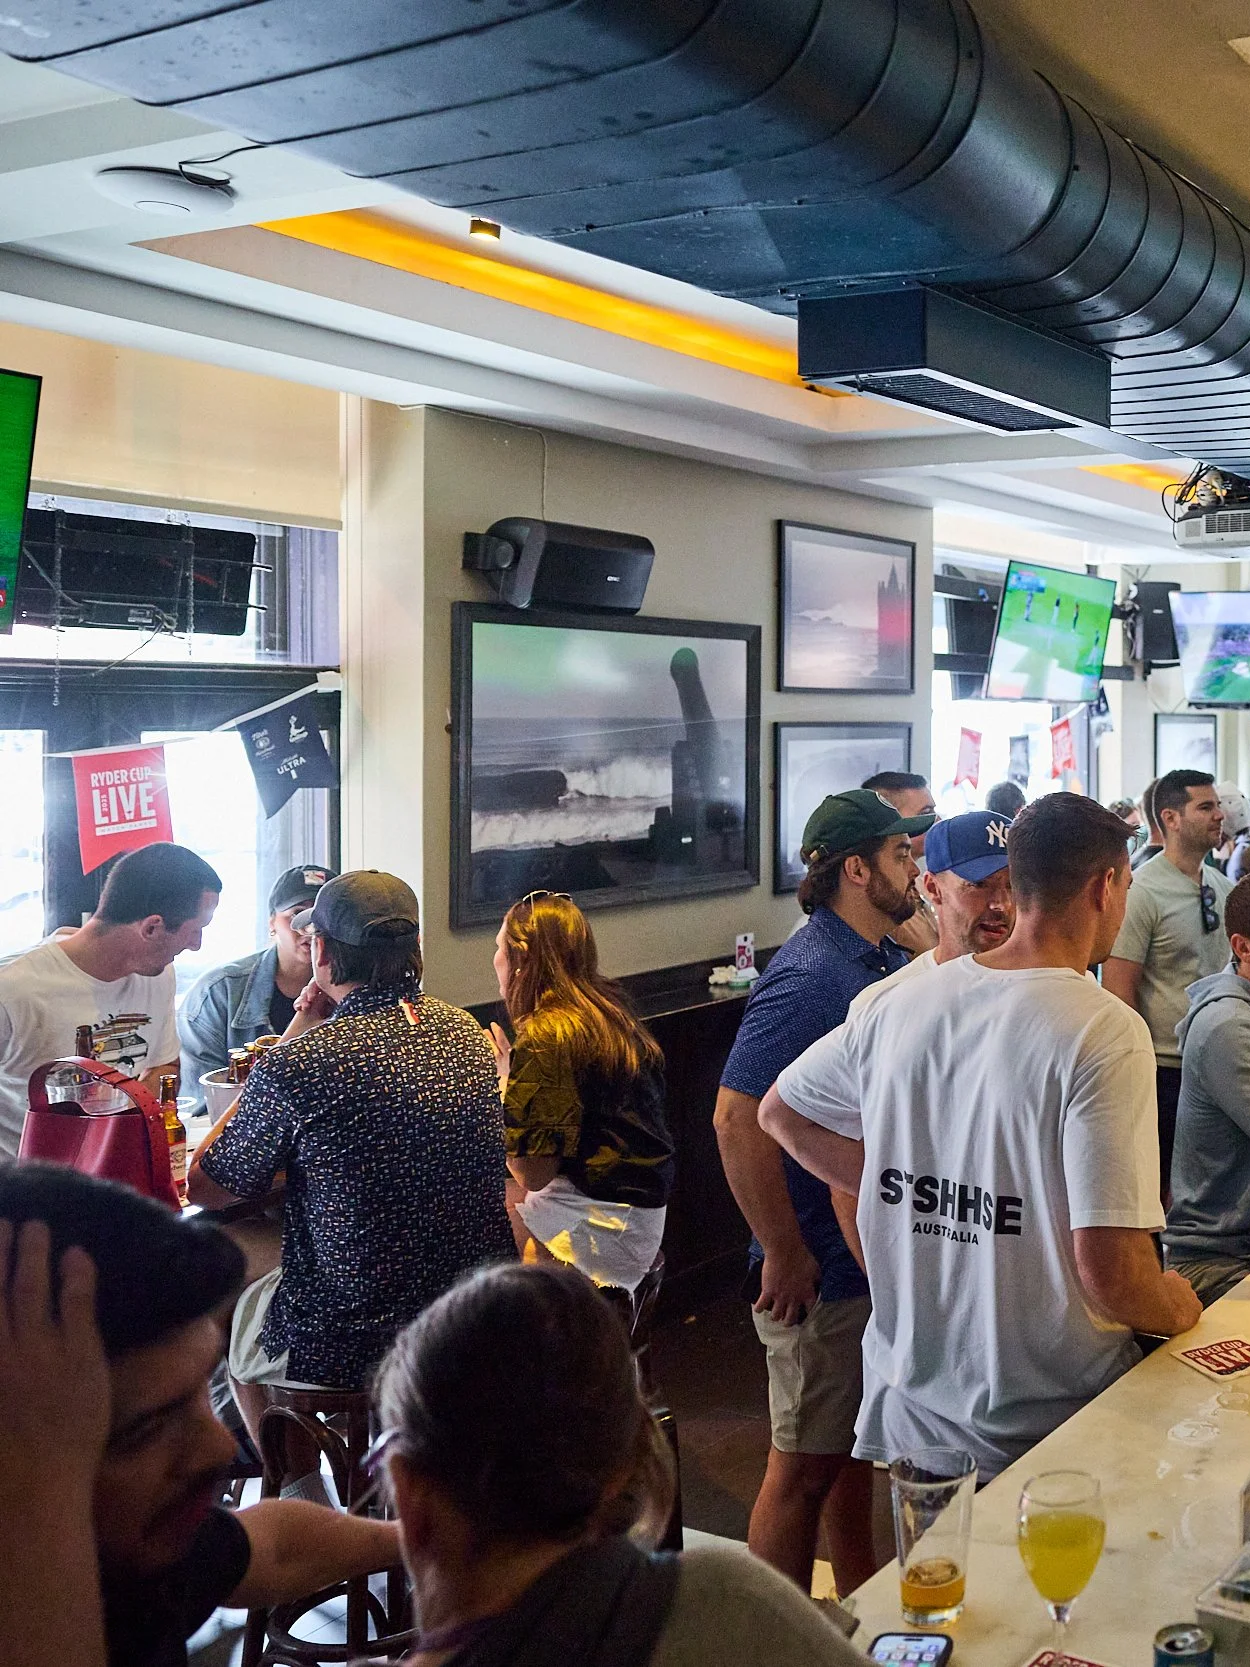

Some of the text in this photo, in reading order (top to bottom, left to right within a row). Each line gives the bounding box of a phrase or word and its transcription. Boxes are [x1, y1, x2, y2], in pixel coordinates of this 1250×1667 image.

[276, 756, 307, 775] ULTRA
[91, 766, 152, 788] RYDER CUP
[92, 782, 156, 826] LIVE
[1185, 1340, 1244, 1359] RYDER CUP
